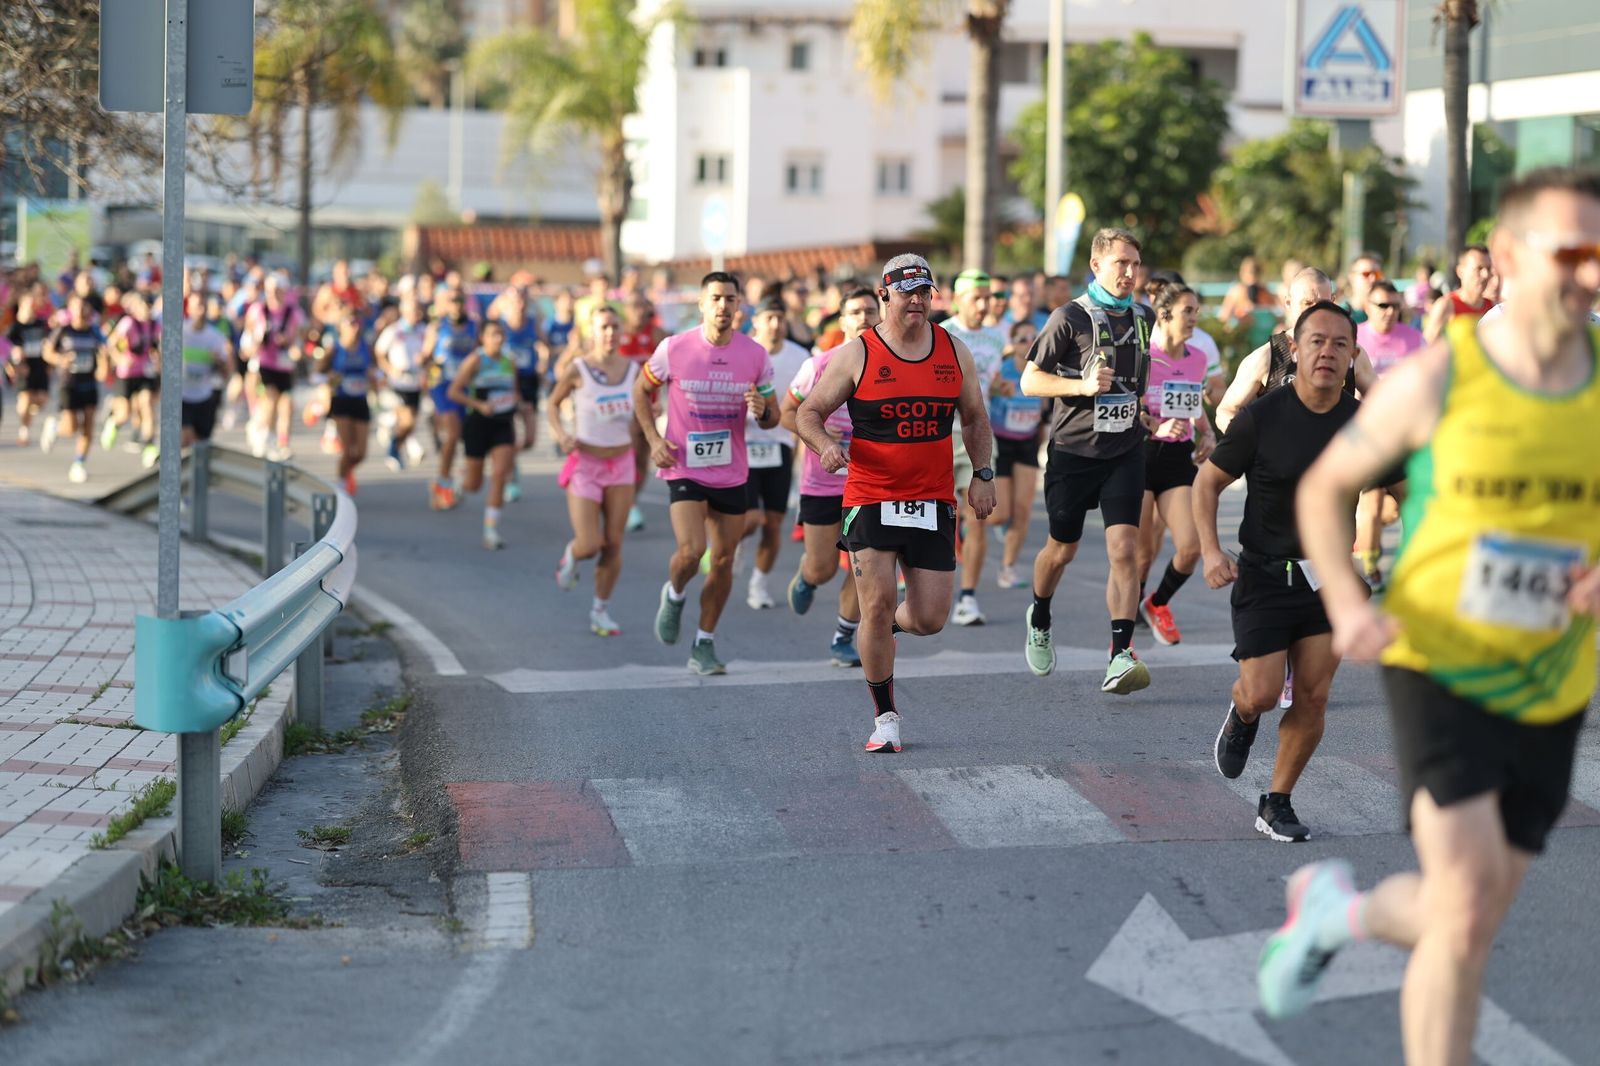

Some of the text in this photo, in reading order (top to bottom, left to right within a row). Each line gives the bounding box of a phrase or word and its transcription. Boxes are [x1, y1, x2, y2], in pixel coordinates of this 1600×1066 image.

[679, 380, 710, 393] MEDIA
[1164, 392, 1200, 407] 2138
[880, 401, 954, 419] SCOTT
[1097, 403, 1135, 420] 2465
[897, 420, 939, 438] GBR
[694, 441, 724, 456] 677
[892, 500, 925, 518] 181
